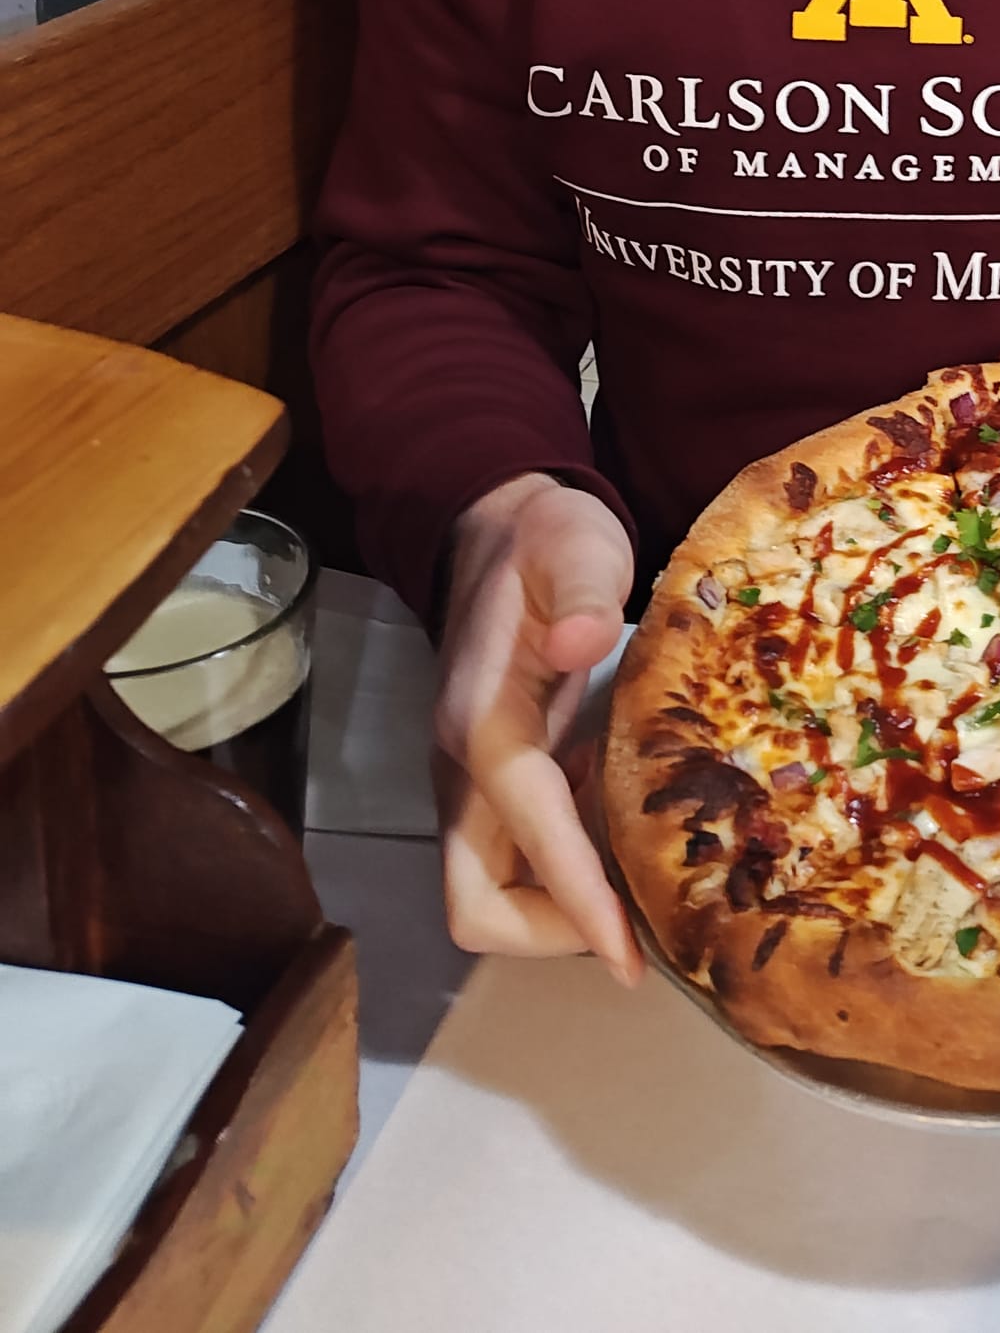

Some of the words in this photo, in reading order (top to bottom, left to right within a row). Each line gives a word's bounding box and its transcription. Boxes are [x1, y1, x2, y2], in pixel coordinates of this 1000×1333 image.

[526, 65, 896, 136] CARLSON
[642, 144, 699, 173] OF
[574, 194, 834, 298] UNIVERSITY
[848, 261, 916, 301] OF
